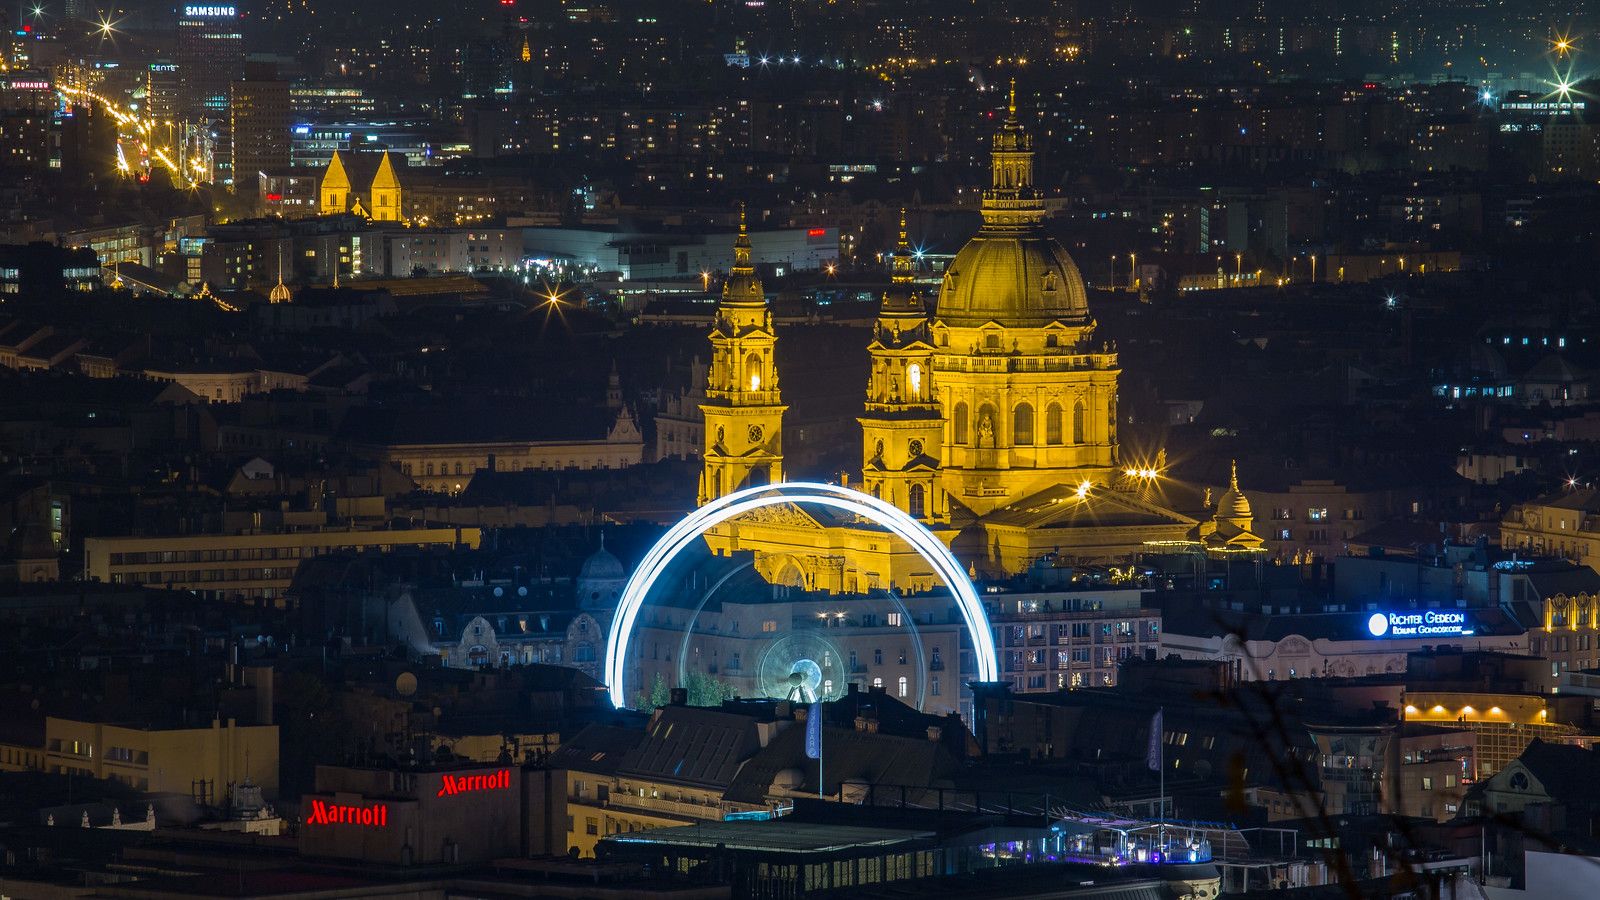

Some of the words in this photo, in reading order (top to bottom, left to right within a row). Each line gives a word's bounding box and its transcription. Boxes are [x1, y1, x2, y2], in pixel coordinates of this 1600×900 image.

[185, 6, 235, 16] SAMSUNG
[1389, 612, 1423, 625] RICHTER
[1425, 611, 1464, 623] GEDEON
[437, 770, 511, 797] Marriott
[306, 799, 388, 827] Marriott
